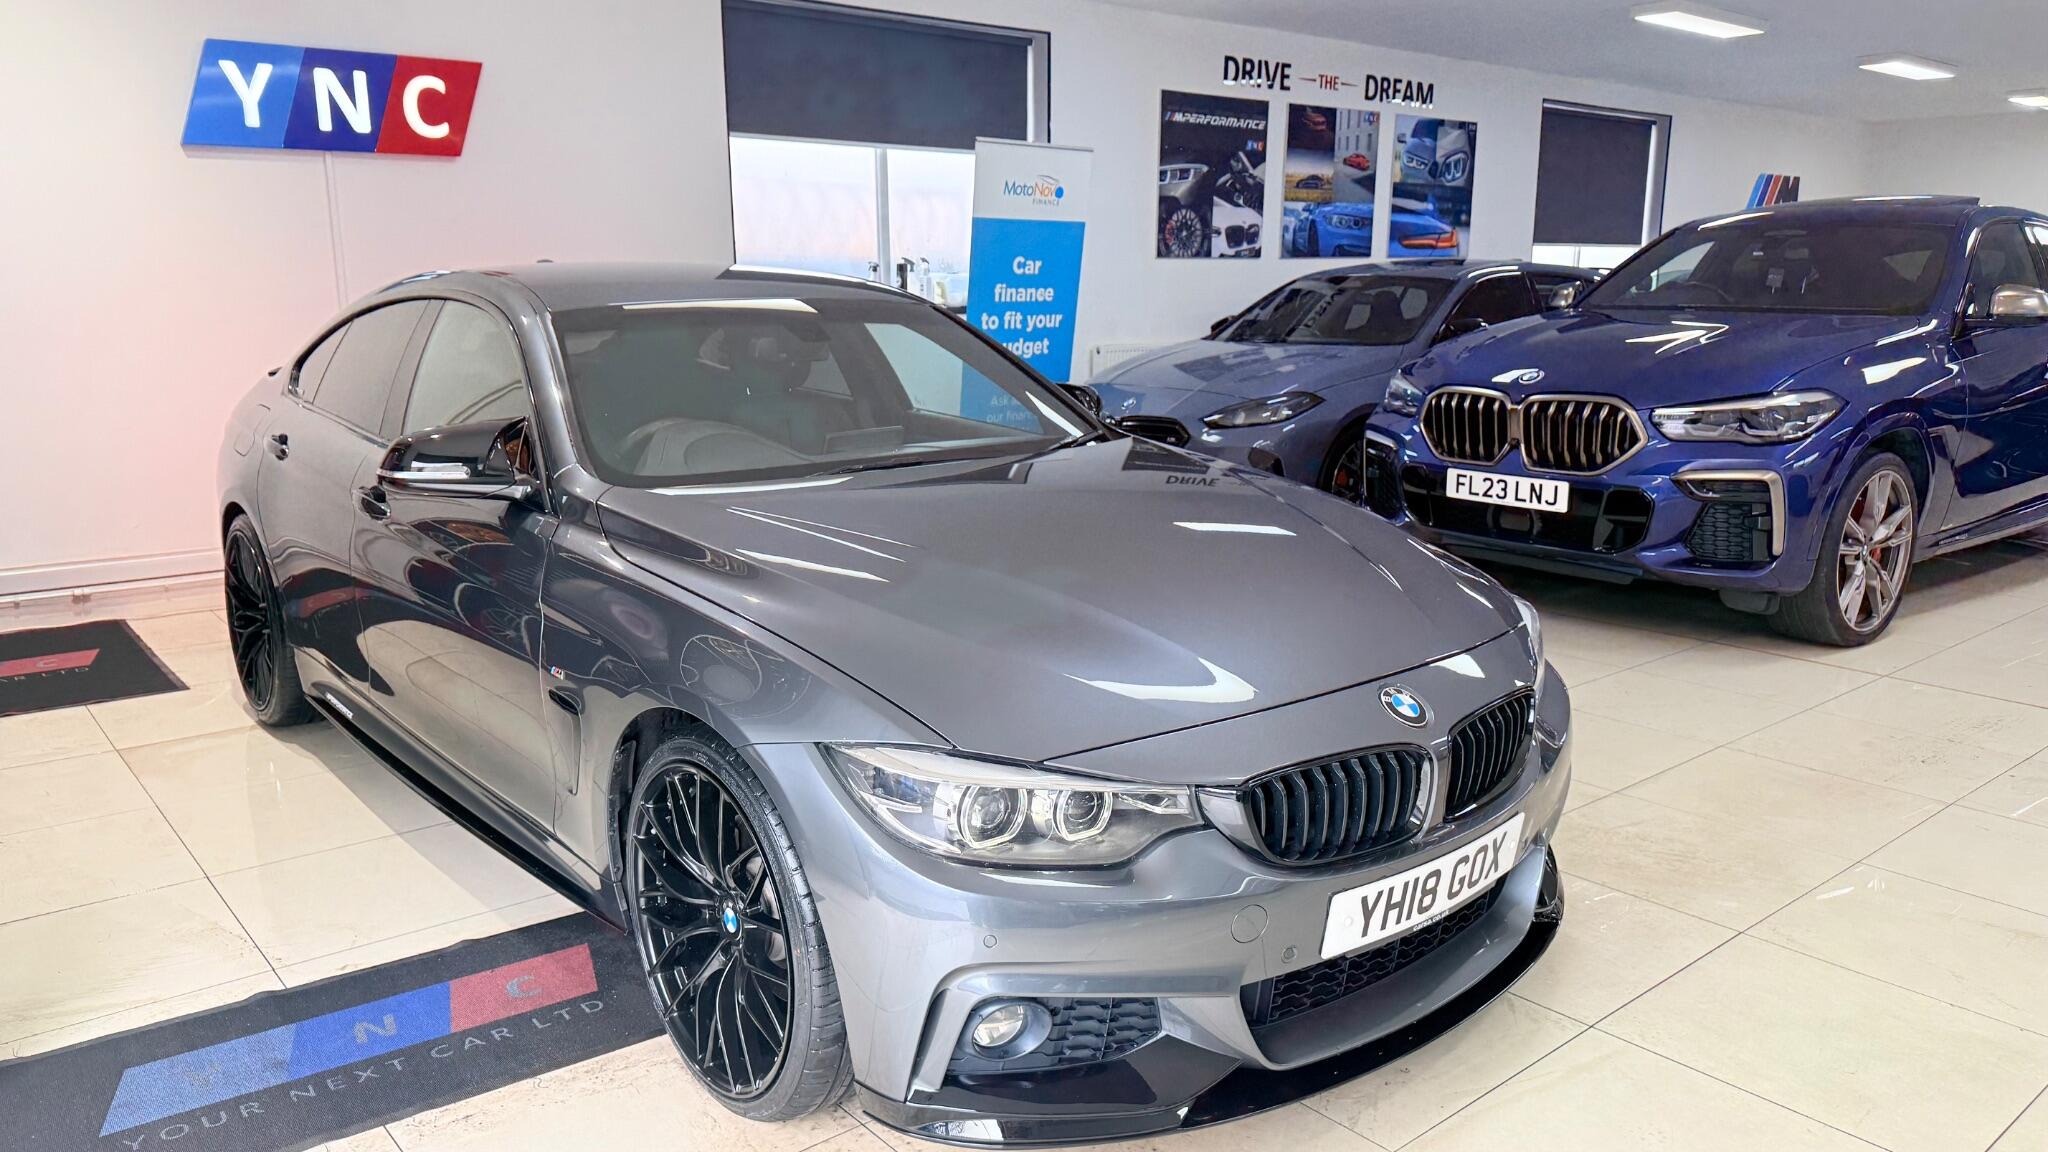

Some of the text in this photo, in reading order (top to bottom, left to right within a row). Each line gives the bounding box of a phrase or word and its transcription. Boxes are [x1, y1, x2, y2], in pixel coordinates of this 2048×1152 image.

[1222, 55, 1435, 109] DRIVE THE DREAM
[217, 59, 451, 139] YNC
[1012, 256, 1042, 275] Car
[994, 283, 1054, 303] finance
[981, 311, 1063, 332] to fit your
[1002, 338, 1050, 359] udget
[1455, 474, 1559, 506] FL23 LNJ
[1361, 831, 1507, 938] YH18 GOX
[123, 1000, 604, 1151] YOUR NEXT CAR LTD
